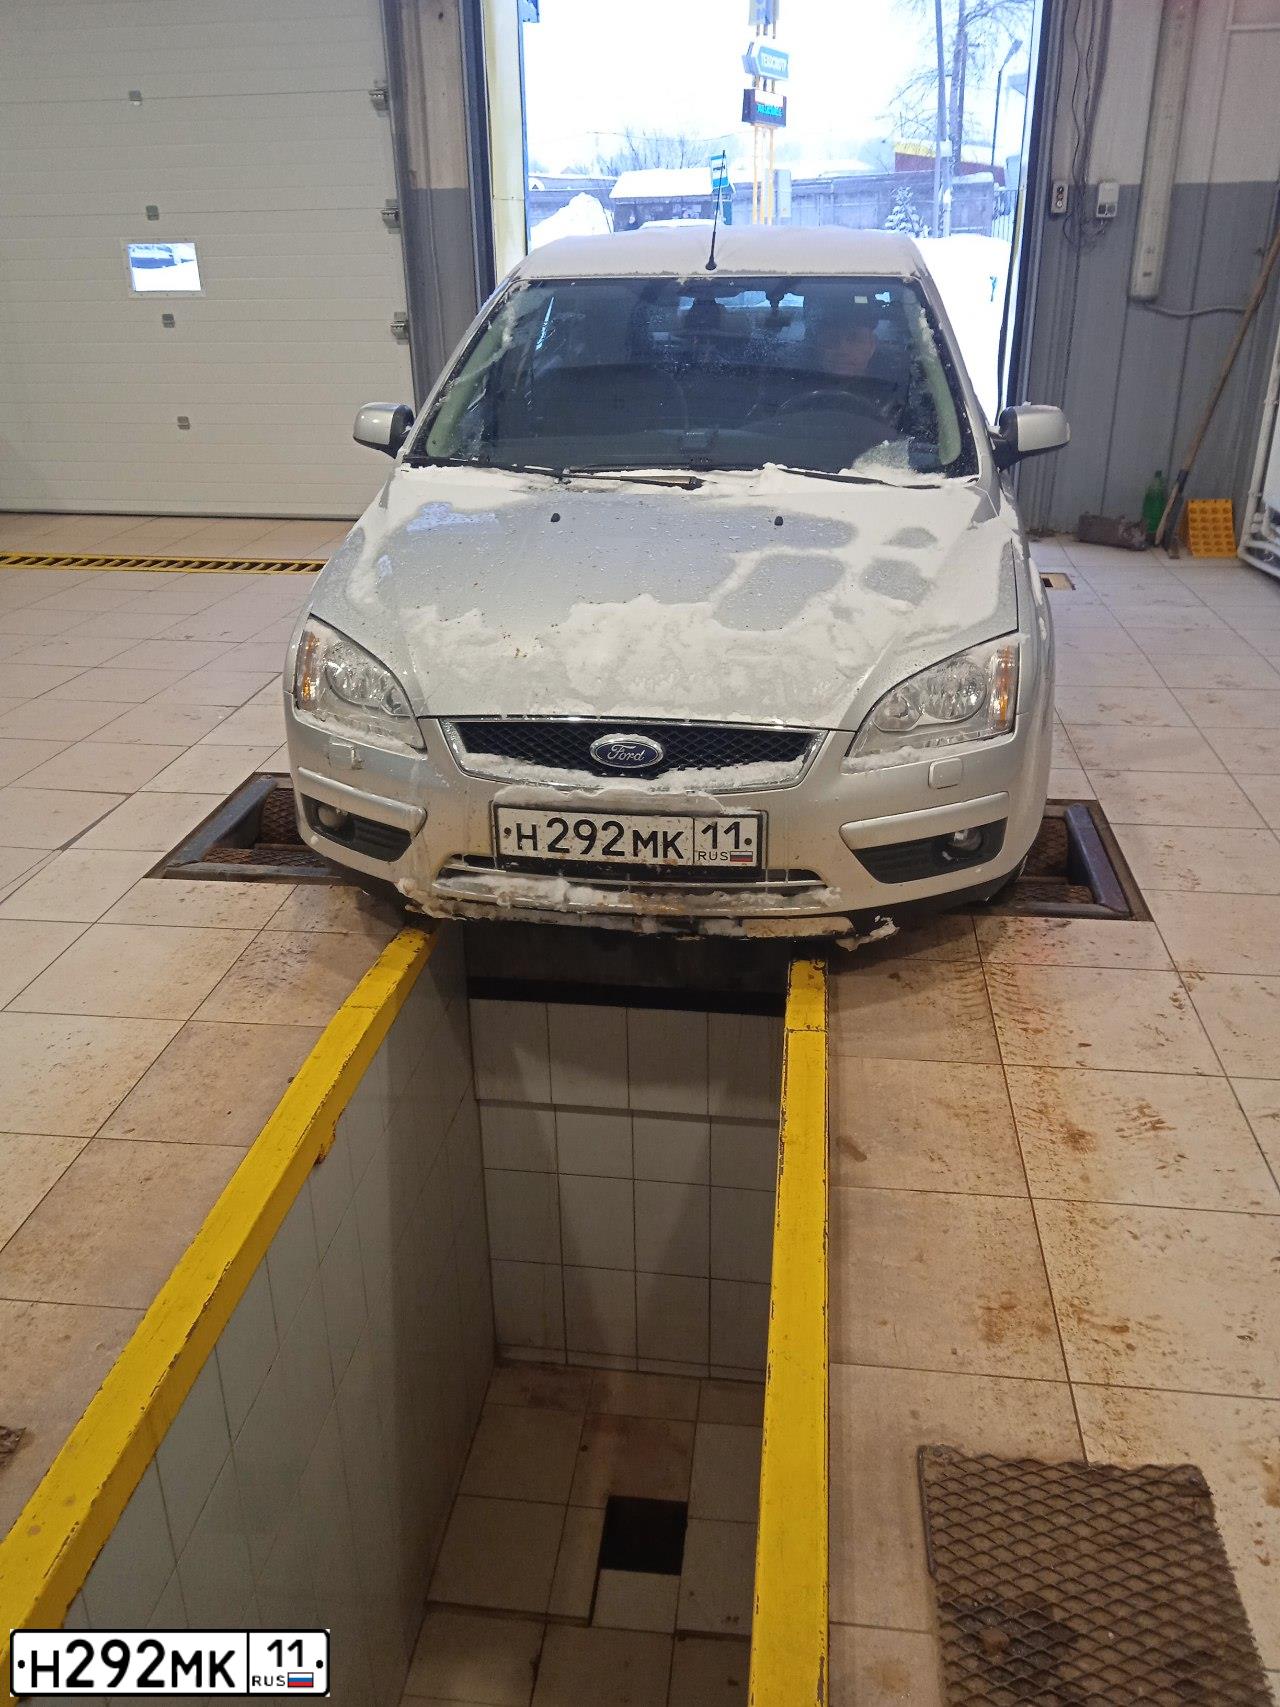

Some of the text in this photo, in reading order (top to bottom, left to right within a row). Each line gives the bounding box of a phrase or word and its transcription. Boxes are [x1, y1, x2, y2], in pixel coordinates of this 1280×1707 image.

[607, 744, 646, 762] Ford
[701, 821, 742, 849] 11
[698, 850, 729, 861] RUS
